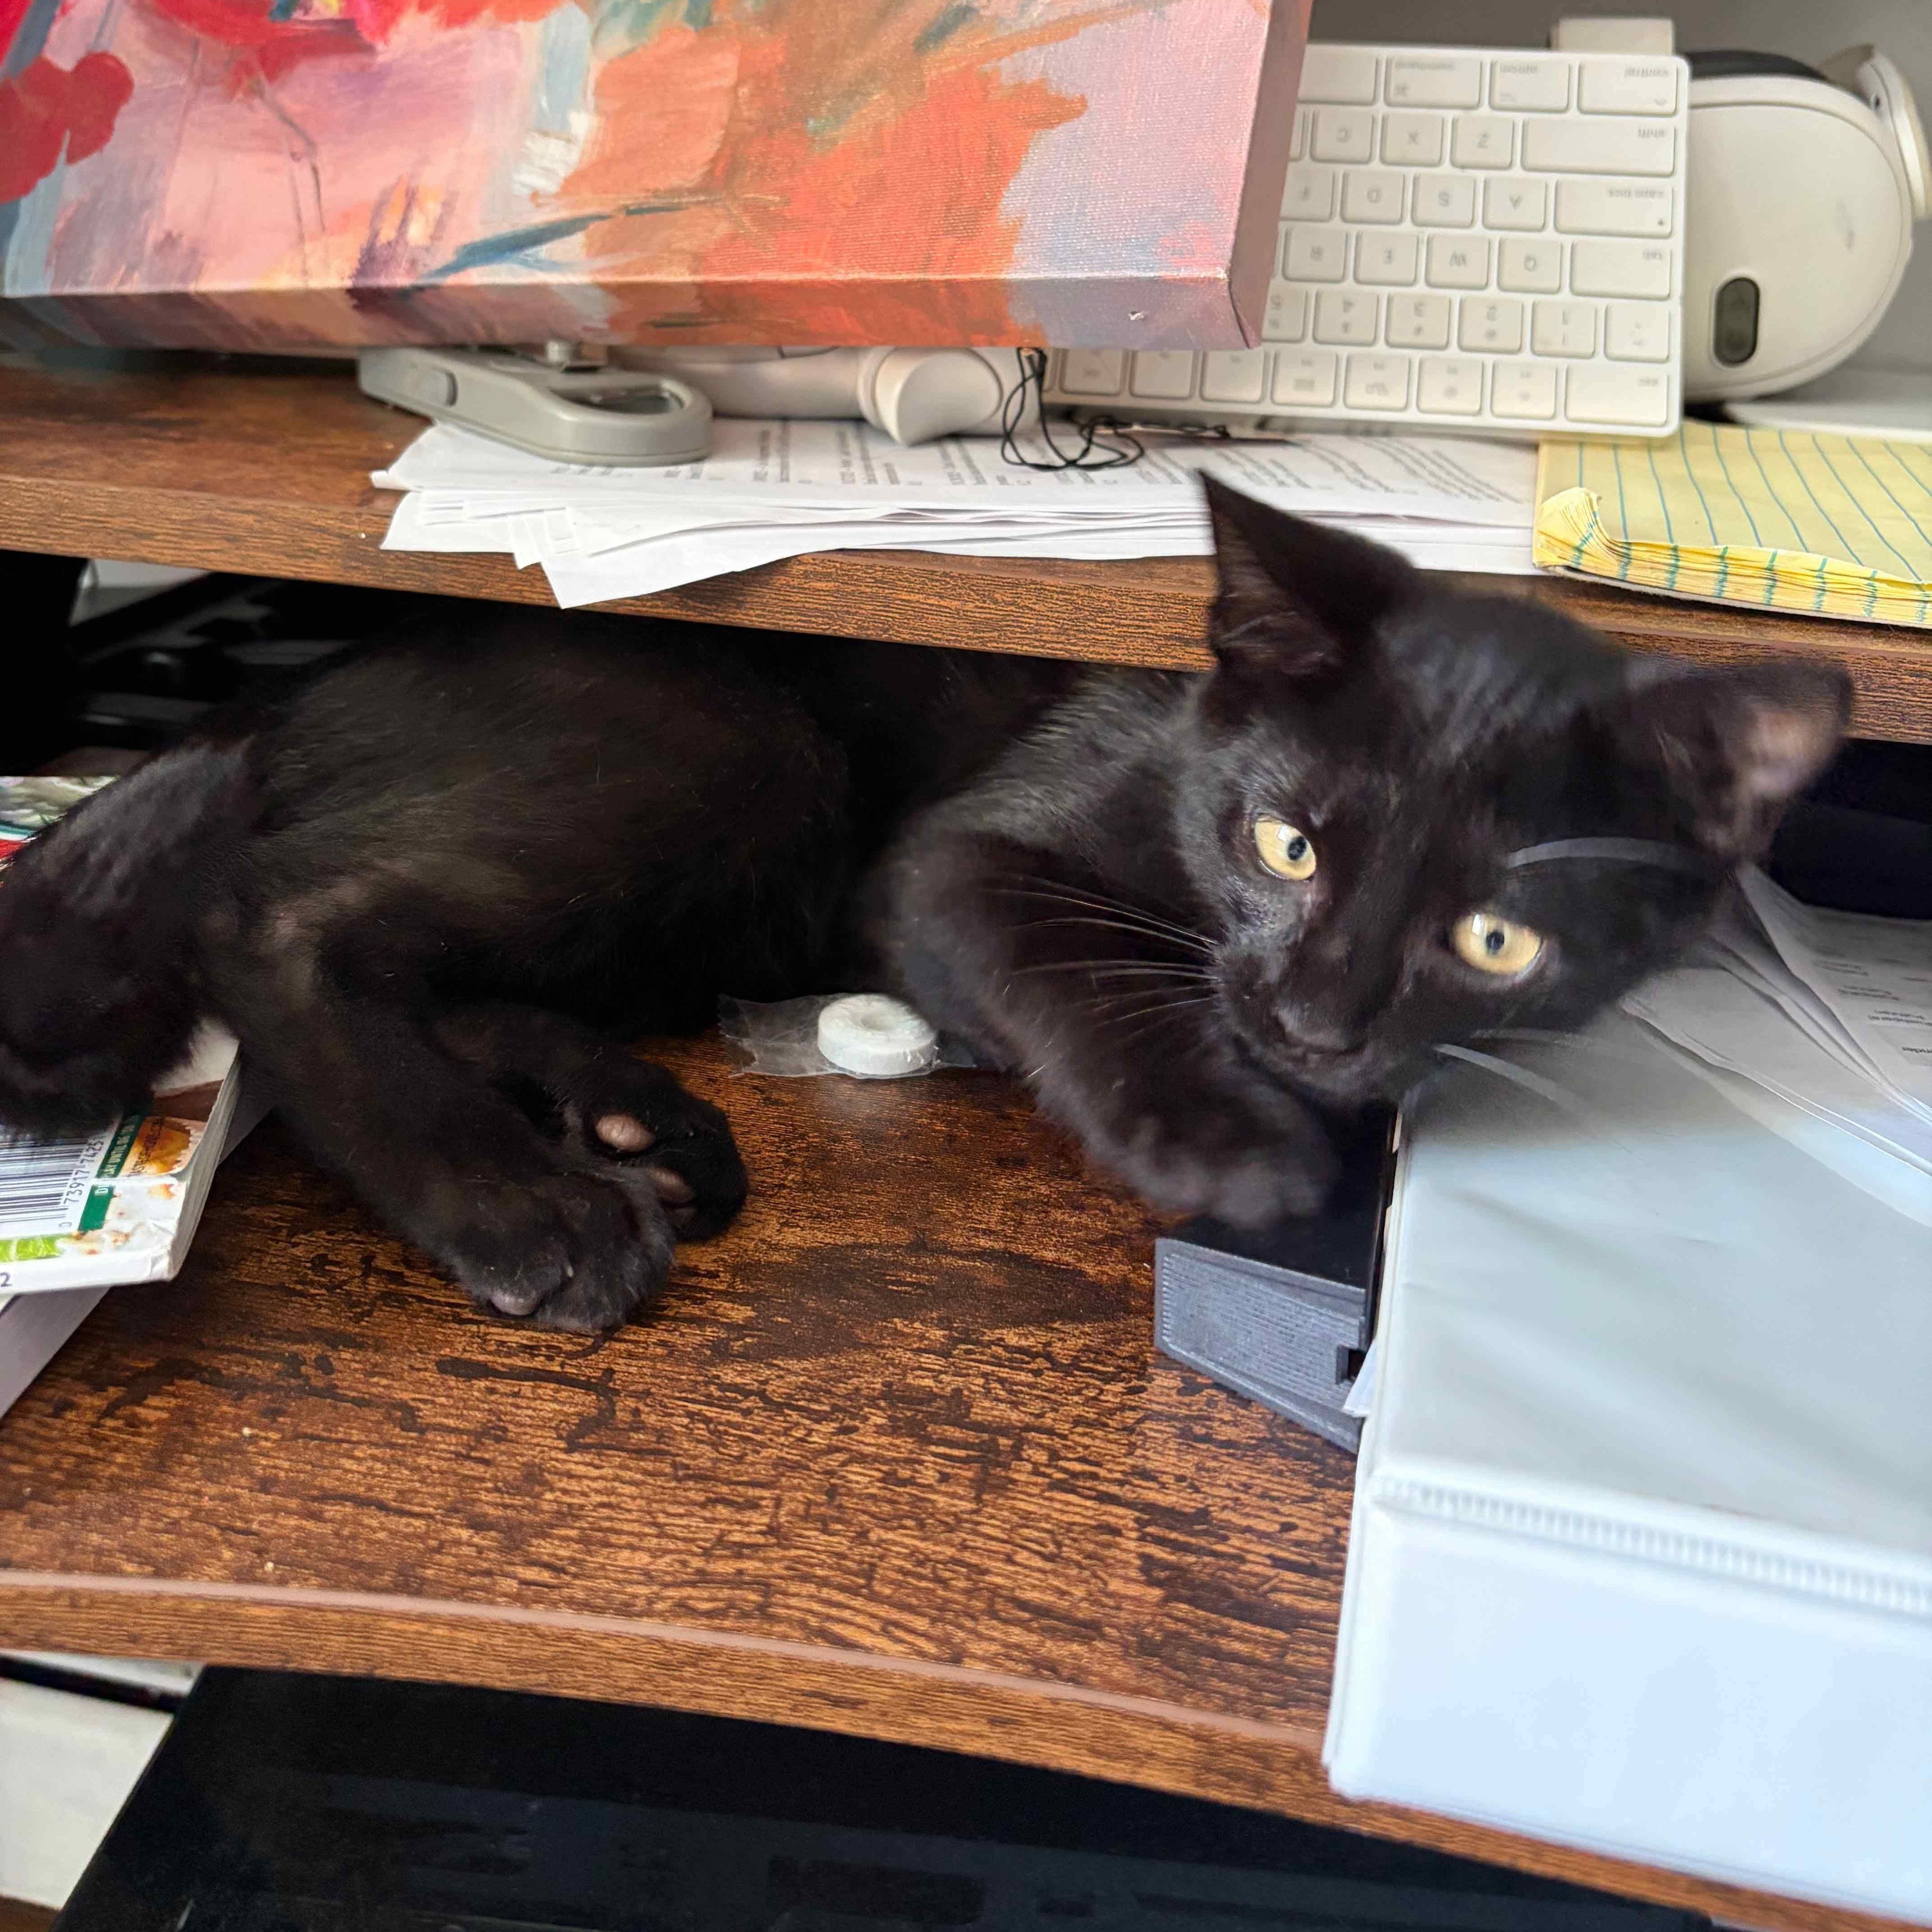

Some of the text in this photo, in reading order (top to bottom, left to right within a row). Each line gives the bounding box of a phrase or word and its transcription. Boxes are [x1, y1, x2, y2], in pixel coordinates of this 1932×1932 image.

[1408, 131, 1419, 145] X
[1477, 132, 1490, 149] Z
[1638, 127, 1666, 139] shift
[1366, 187, 1382, 204] D
[1438, 190, 1450, 207] S
[1509, 195, 1523, 210] A
[1384, 248, 1393, 265] E
[1449, 251, 1467, 267] W
[1523, 254, 1538, 272] Q
[64, 1167, 89, 1205] 73917
